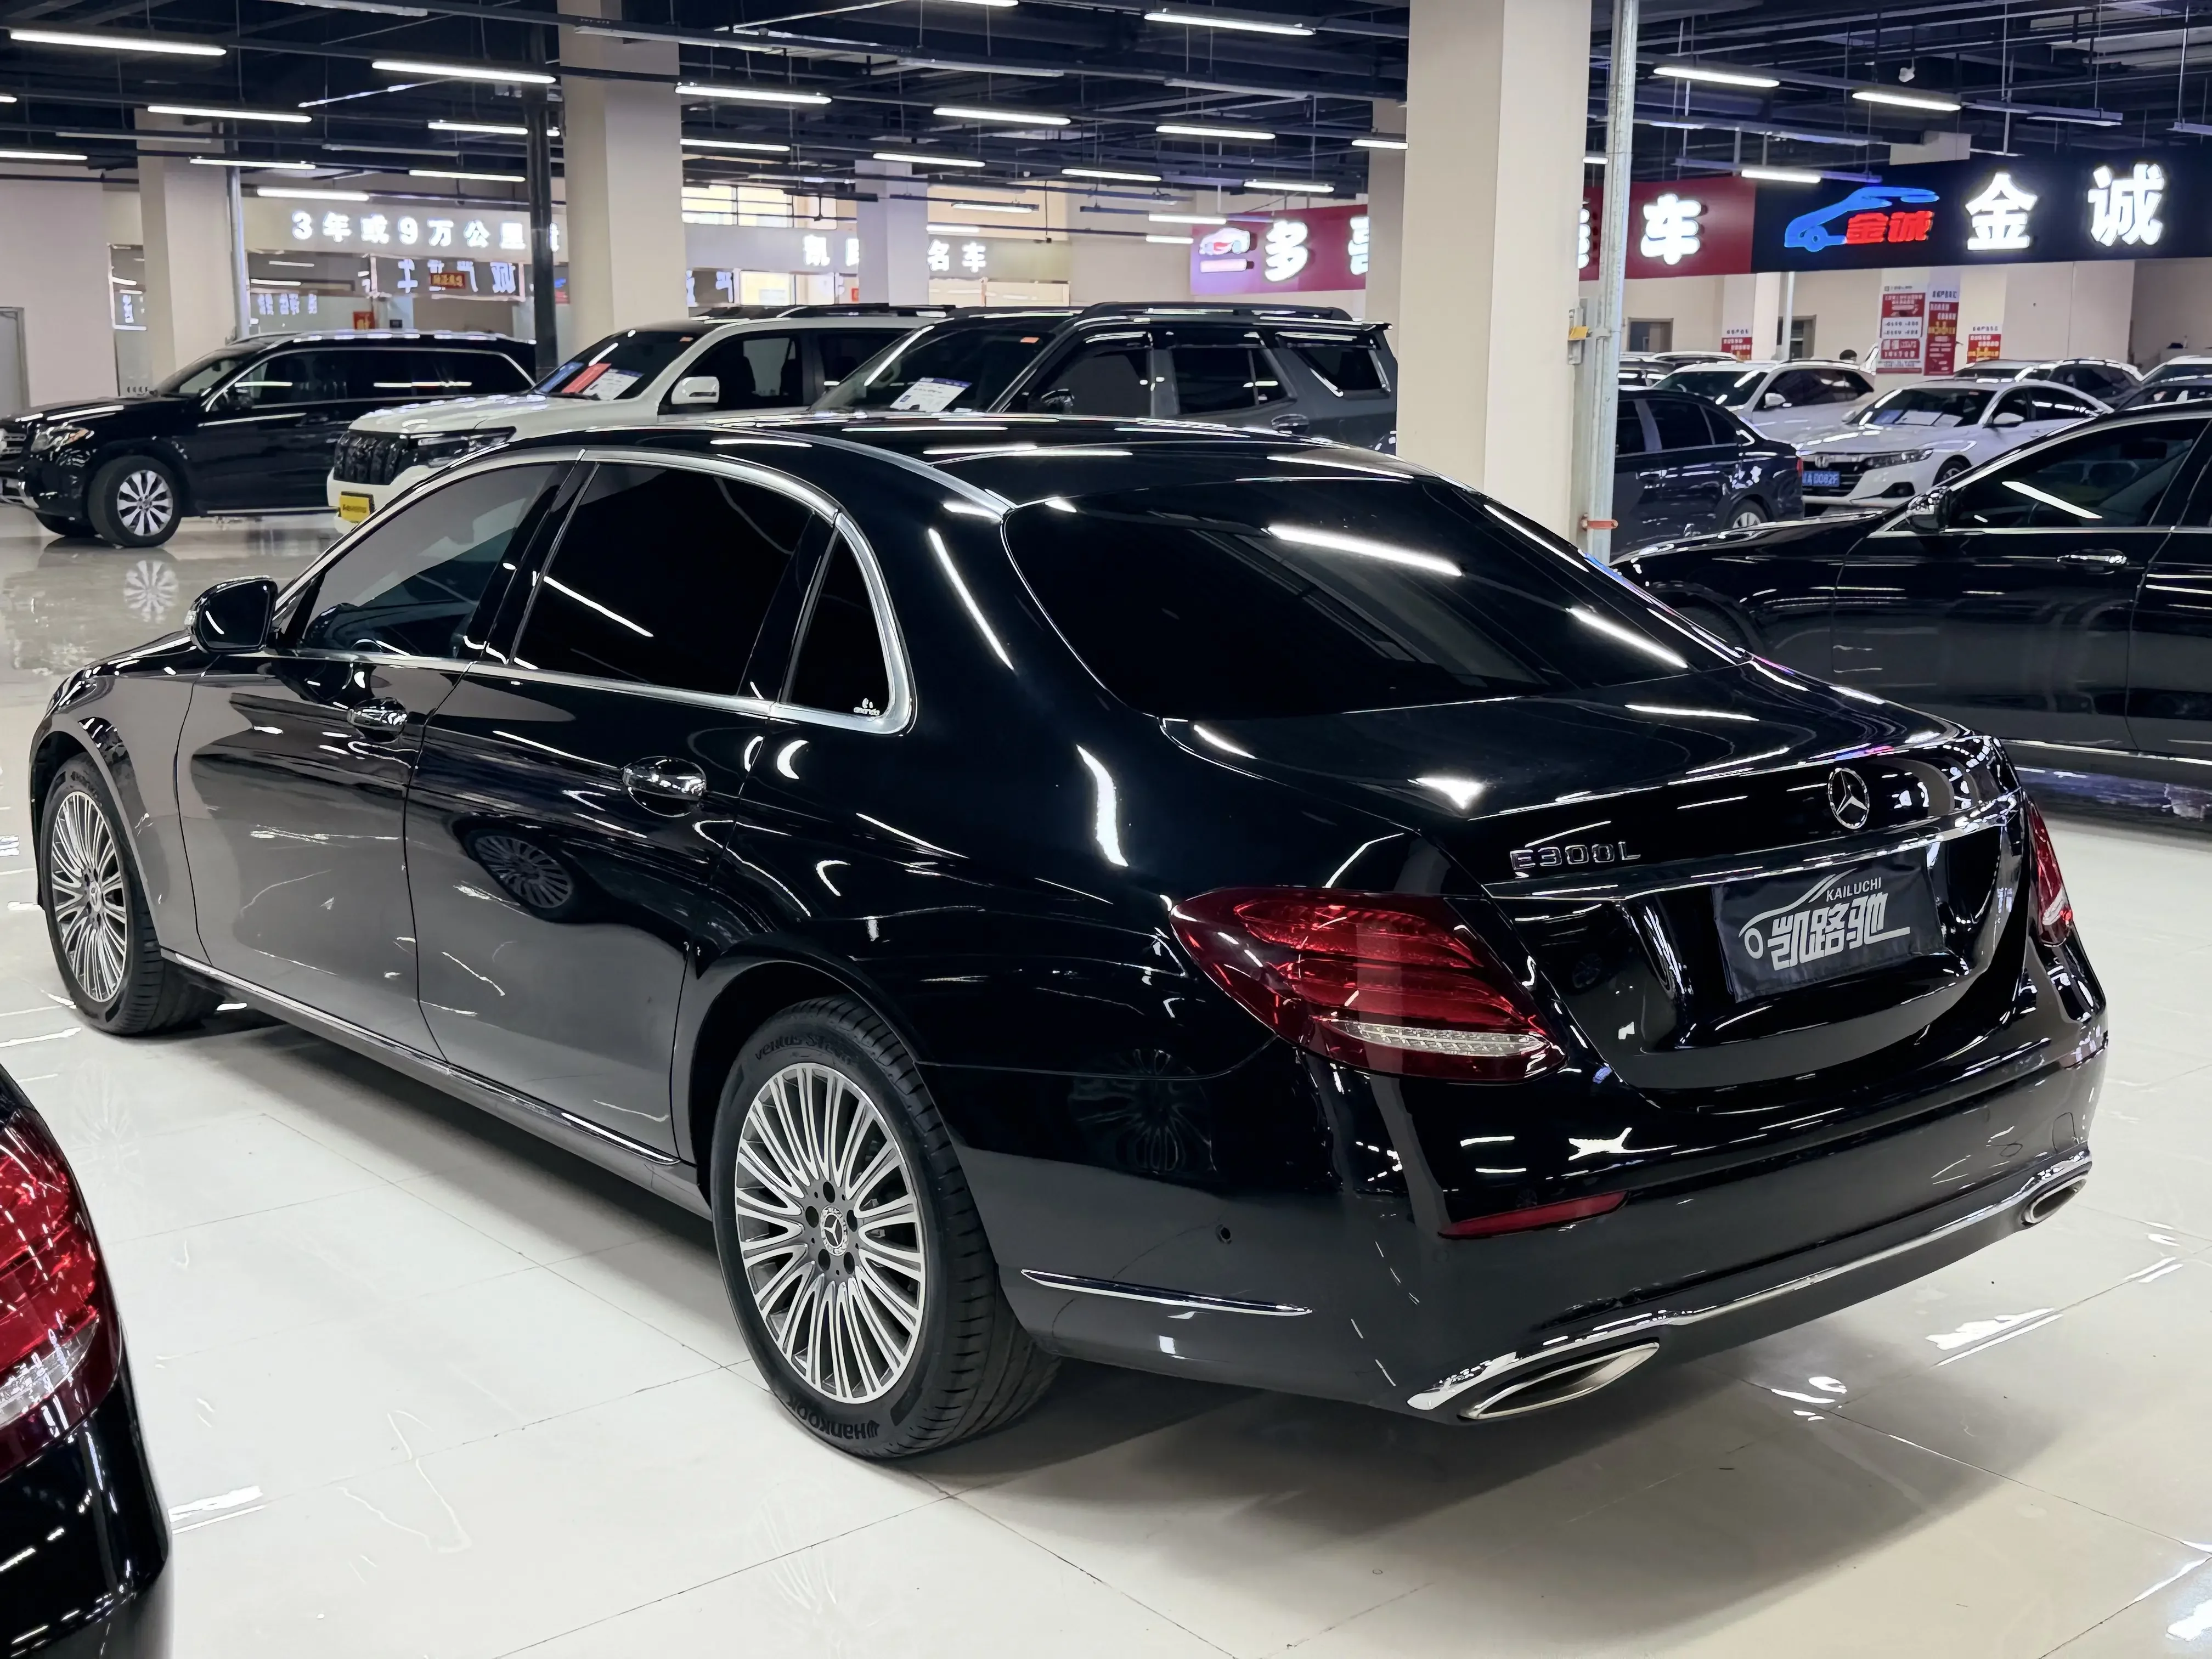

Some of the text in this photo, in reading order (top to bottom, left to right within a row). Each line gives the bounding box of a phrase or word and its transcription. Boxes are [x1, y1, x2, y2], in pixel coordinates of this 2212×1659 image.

[1965, 162, 2165, 251] 金诚
[1846, 211, 1934, 245] 金诚
[1510, 841, 1641, 871] E300L
[1826, 877, 1882, 902] KAILUCHI
[1767, 892, 1910, 971] 凯路驰
